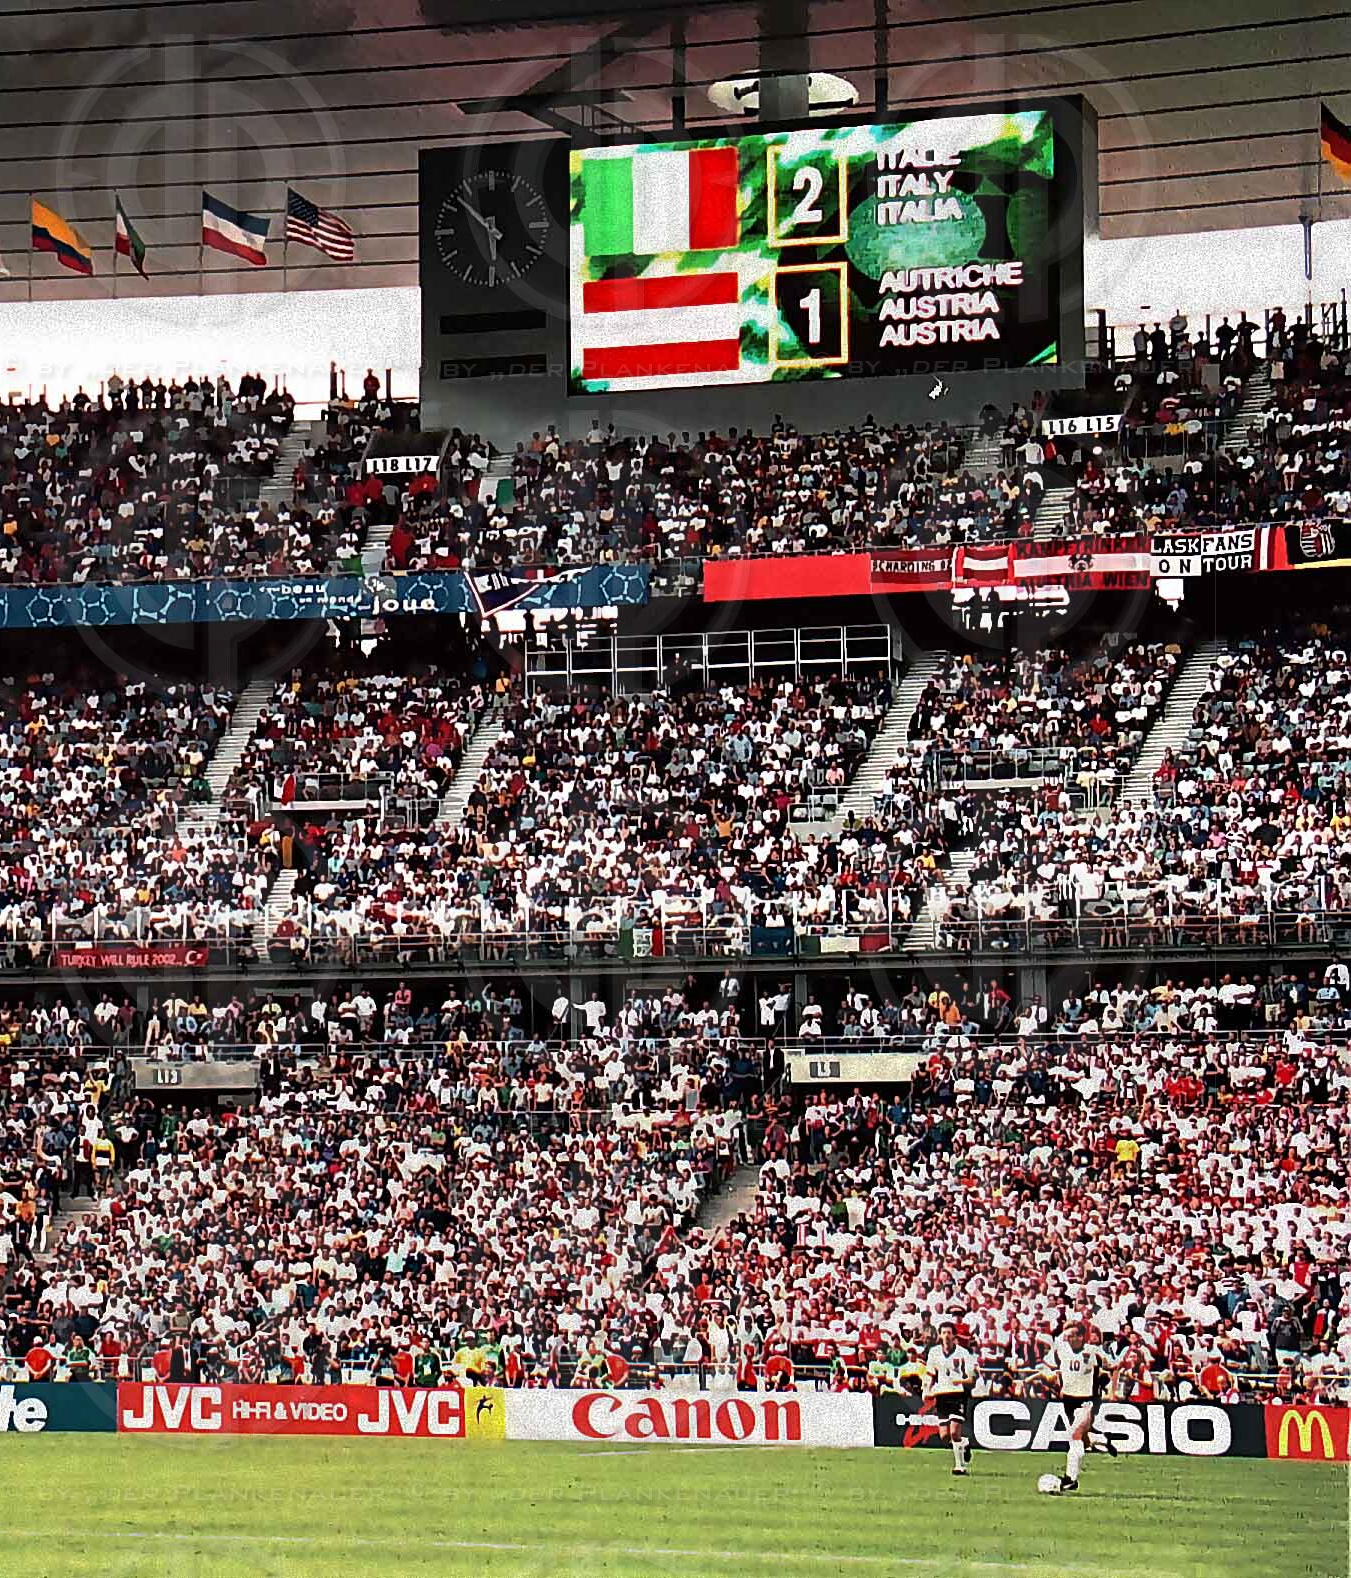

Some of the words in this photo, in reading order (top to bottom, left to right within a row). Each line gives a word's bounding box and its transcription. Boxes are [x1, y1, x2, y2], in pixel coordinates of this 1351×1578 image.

[792, 166, 823, 223] 2
[877, 170, 954, 198] ITALY
[877, 197, 963, 225] ITALIA
[879, 261, 1024, 294] AUTRICHE
[799, 288, 821, 344] 1
[879, 291, 1000, 320] AUSTRIA
[879, 318, 1001, 347] AUSTRIA
[1049, 420, 1077, 434] L16
[1086, 416, 1114, 432] L15
[373, 459, 399, 473] L18
[406, 457, 432, 472] L17
[1150, 538, 1199, 554] LASK
[1202, 533, 1253, 551] FANS
[1203, 554, 1252, 572] TOUR
[61, 953, 96, 968] TURKEY
[100, 953, 124, 967] WILL
[126, 953, 149, 968] RULE
[1070, 1360, 1081, 1371] 10
[123, 1385, 223, 1431] JVC
[290, 1402, 348, 1422] VIDEO
[357, 1389, 460, 1435] JVC
[571, 1392, 802, 1441] Canon
[973, 1400, 1232, 1456] CASIO
